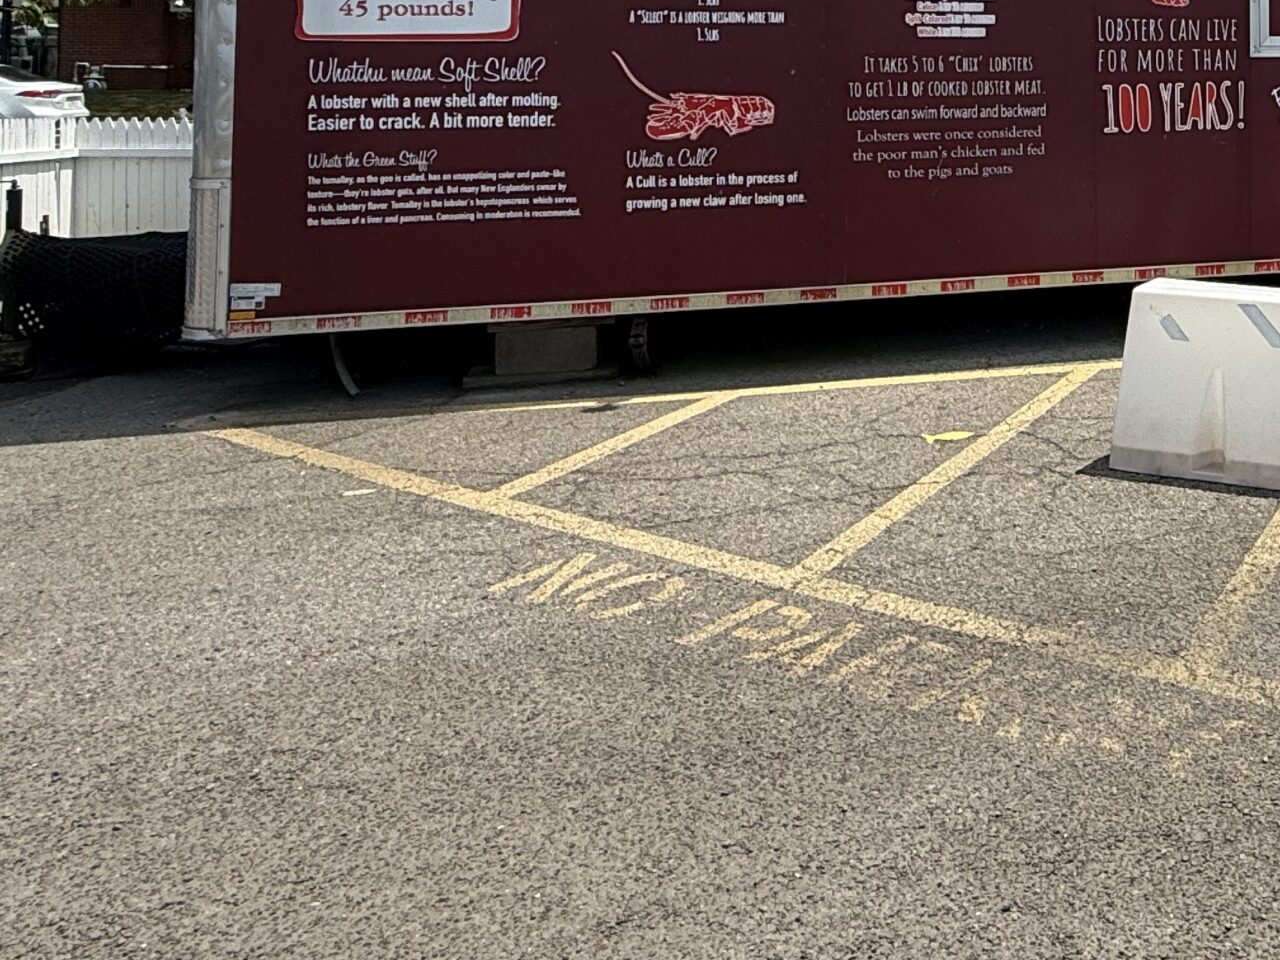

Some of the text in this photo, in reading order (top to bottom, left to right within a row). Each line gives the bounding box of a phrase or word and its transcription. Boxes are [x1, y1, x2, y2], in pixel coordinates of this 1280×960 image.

[339, 0, 474, 21] 45 pounds!
[1098, 16, 1237, 42] LOBSTERS CAN LIVE
[864, 56, 874, 73] IT
[879, 56, 908, 73] TAKES
[912, 55, 918, 73] 5
[923, 57, 934, 73] TO
[939, 56, 944, 73] 6
[990, 56, 1033, 72] LOBSTERS
[1098, 49, 1237, 73] FOR MORE THAN
[309, 56, 546, 92] Whatchu mean Soft Shell?
[849, 82, 861, 98] TO
[866, 82, 884, 98] GET
[912, 81, 924, 97] OF
[928, 80, 968, 96] COOKED
[972, 80, 1011, 96] LOBSTER
[307, 92, 561, 110] A lobster with a new shell after molting.
[1102, 80, 1244, 133] 100 YEARS!
[308, 111, 556, 131] Easier to crack. A bit more tender.
[847, 102, 1046, 121] Lobsters can swim forward and backward
[857, 125, 1042, 143] Lobsters were once considered
[345, 151, 360, 167] the
[362, 151, 398, 167] Green
[398, 149, 437, 172] Stuff?
[667, 156, 675, 166] a
[678, 147, 717, 167] Cull?
[853, 149, 873, 161] the
[877, 151, 907, 163] poor
[951, 144, 997, 158] chicken
[1000, 143, 1023, 156] and
[1027, 142, 1045, 155] fed
[626, 171, 798, 188] A Cull is a lobster in the process of
[888, 163, 1013, 180] to the pigs and goats
[626, 192, 807, 212] growing a new claw after losing one.
[486, 552, 688, 619] NO
